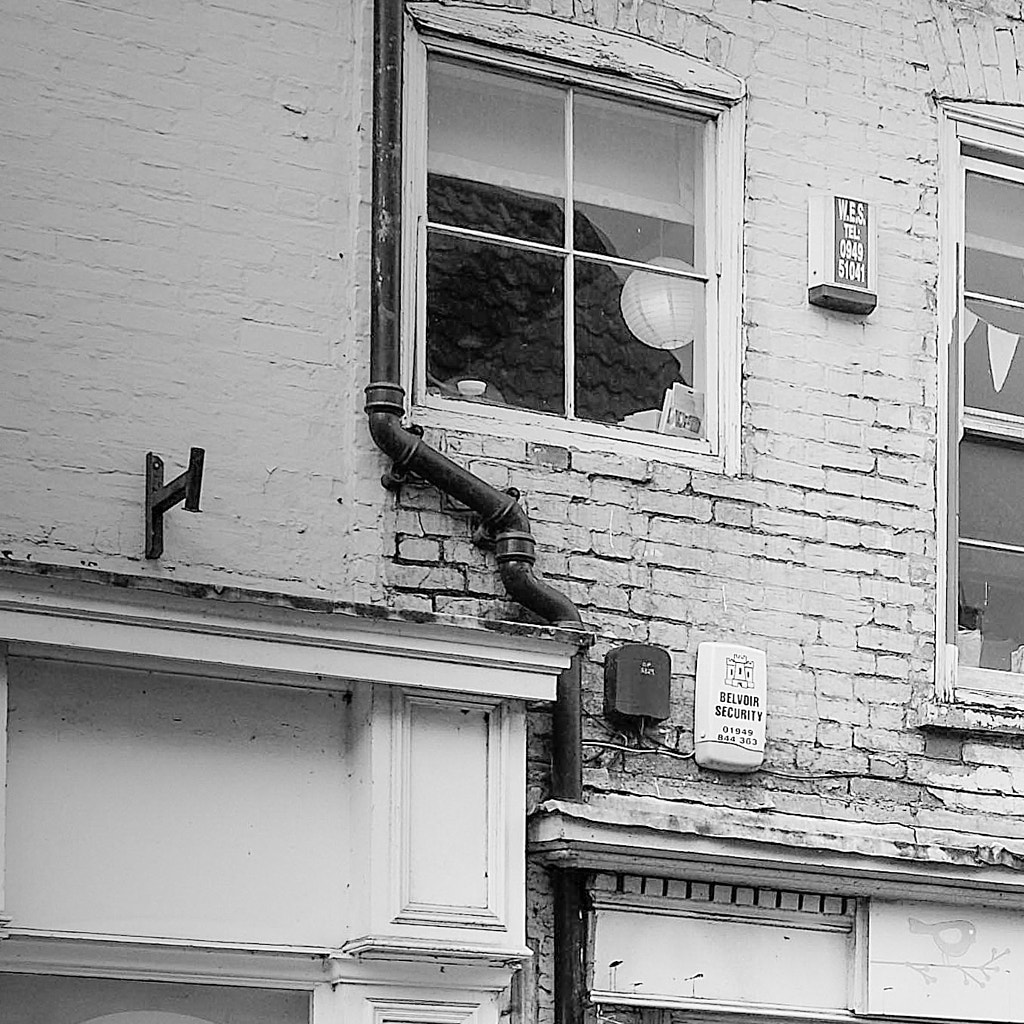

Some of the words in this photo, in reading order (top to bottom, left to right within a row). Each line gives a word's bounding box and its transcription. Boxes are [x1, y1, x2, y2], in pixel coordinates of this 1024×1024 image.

[839, 239, 864, 262] 0949
[838, 258, 865, 282] 51041
[719, 691, 760, 708] BELVOIR
[715, 705, 763, 722] SECURITY
[717, 734, 736, 743] 844
[722, 726, 754, 736] 01949
